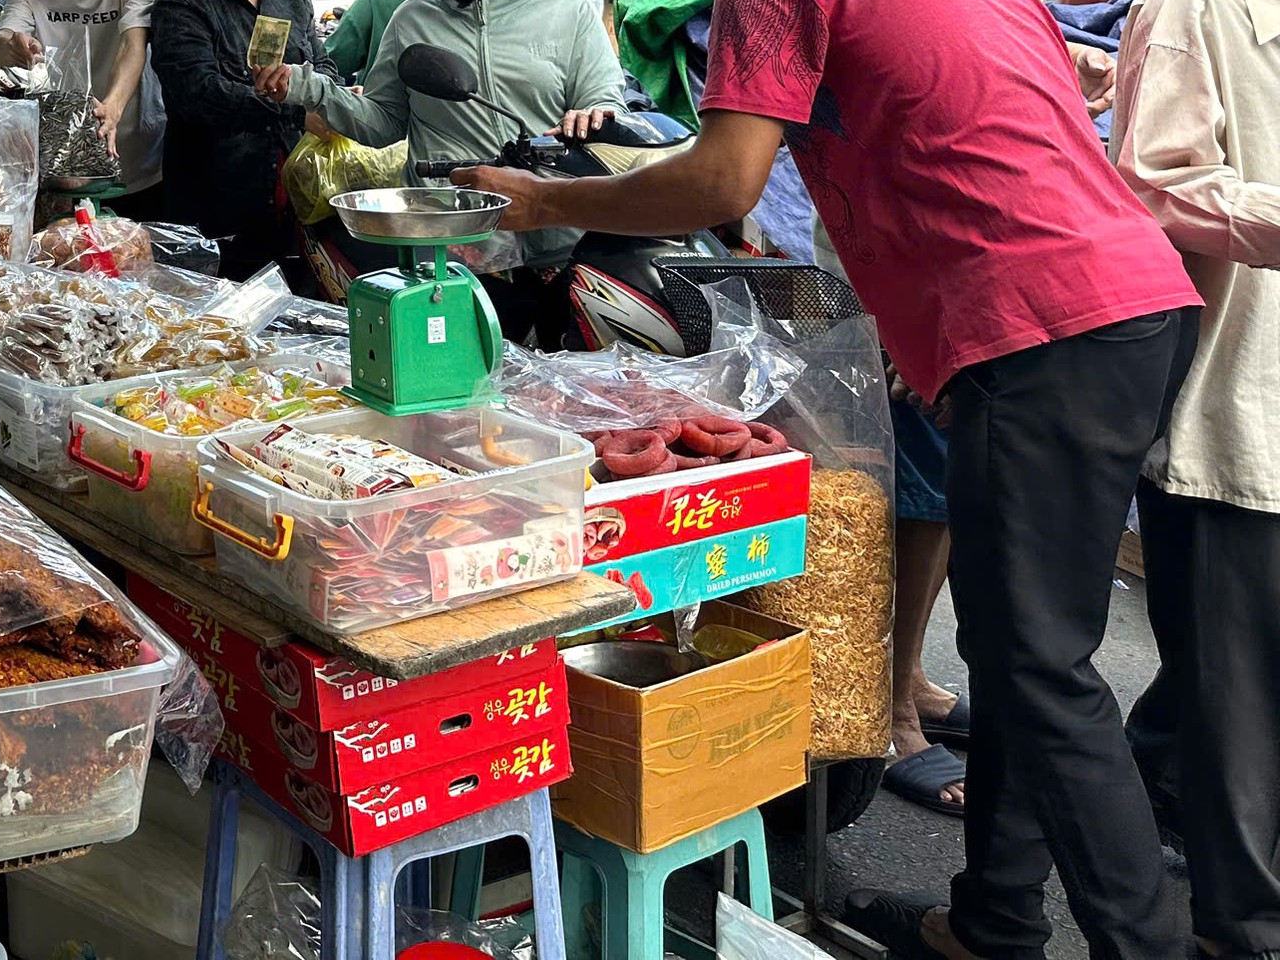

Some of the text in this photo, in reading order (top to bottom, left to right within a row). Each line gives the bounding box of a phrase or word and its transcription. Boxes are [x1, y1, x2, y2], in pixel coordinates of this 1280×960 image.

[706, 567, 777, 593] DRIED PERSIMMON
[482, 681, 553, 726] 성우 곶감
[489, 738, 555, 784] 성우 곶감
